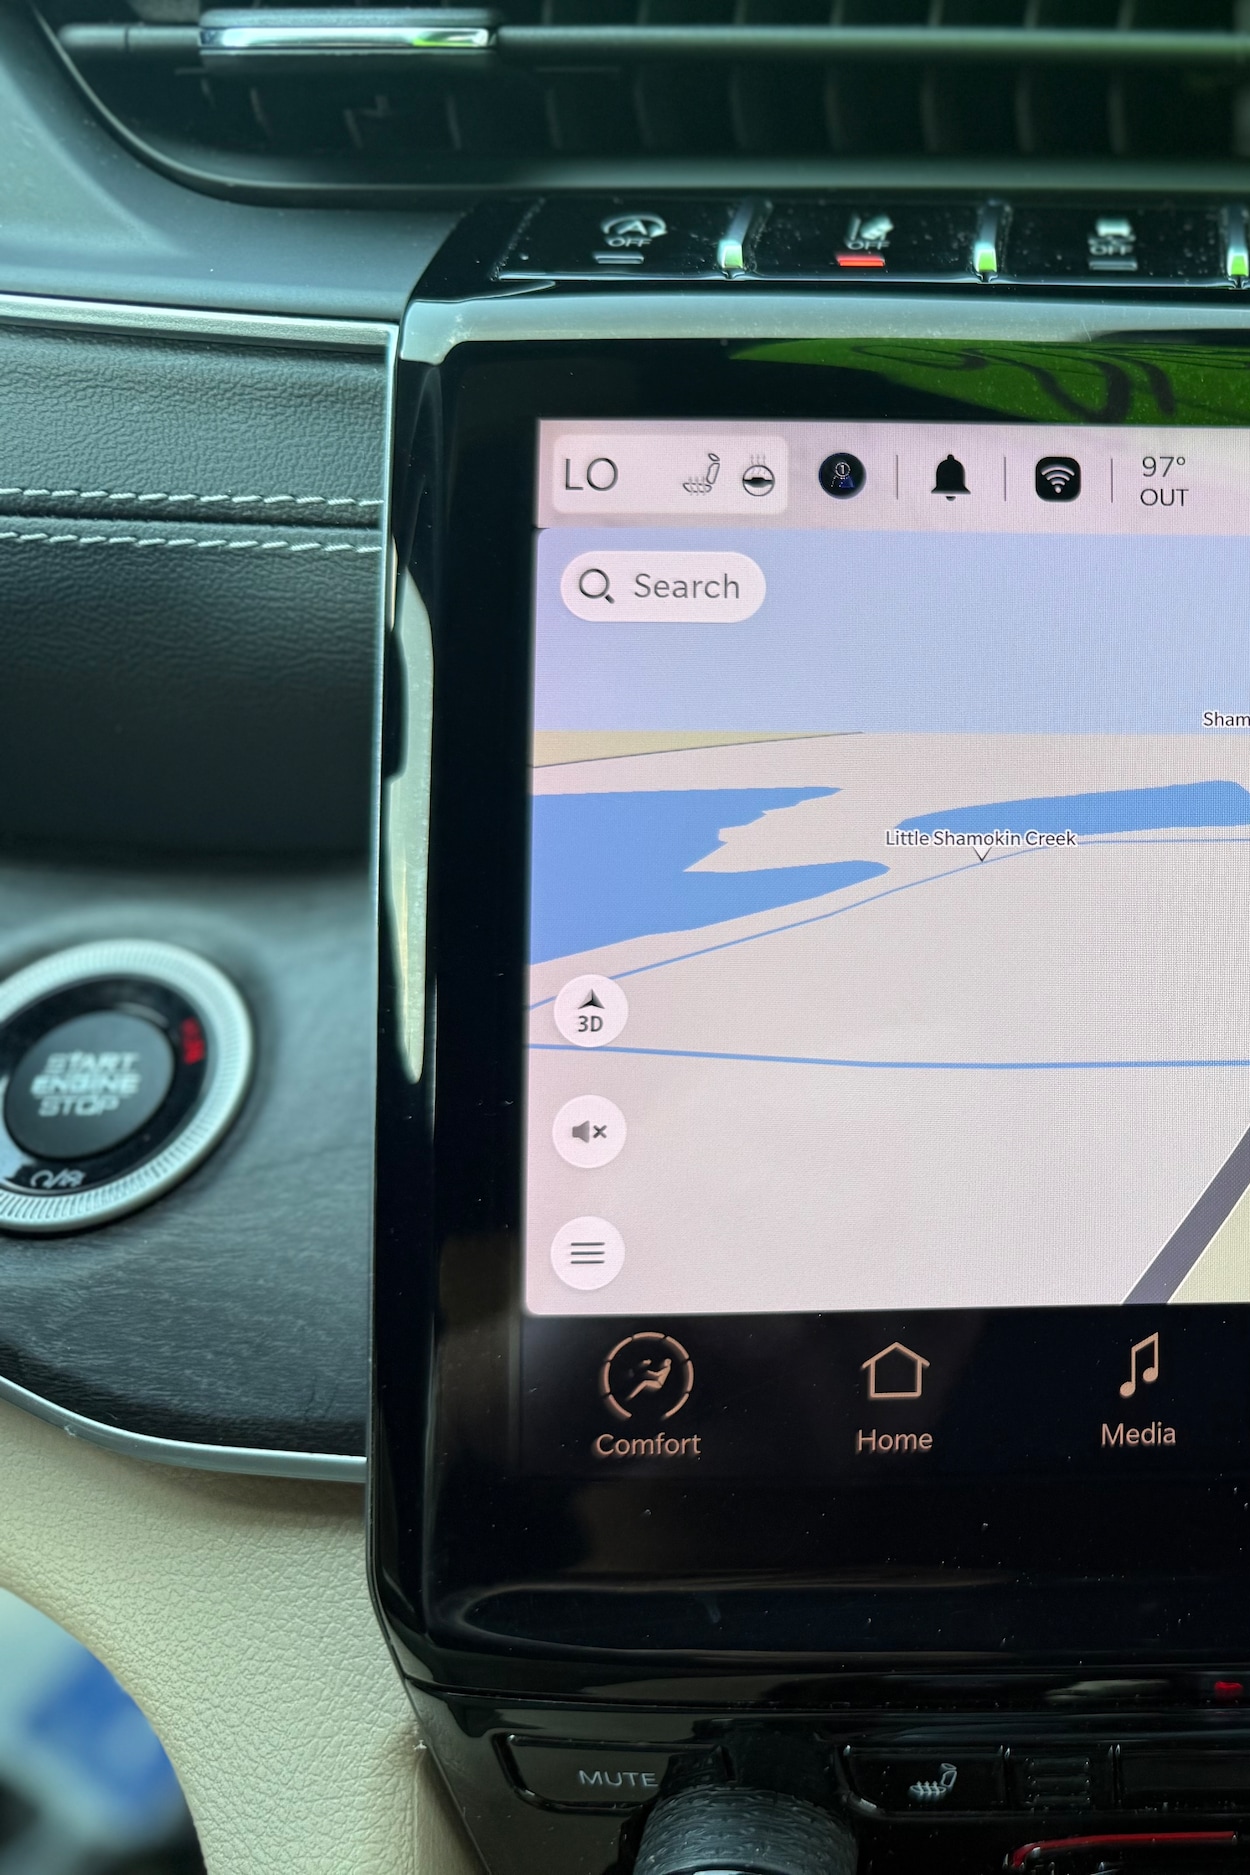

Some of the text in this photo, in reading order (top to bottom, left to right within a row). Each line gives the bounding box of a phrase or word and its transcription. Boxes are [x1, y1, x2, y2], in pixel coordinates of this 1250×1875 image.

[606, 236, 653, 248] OFF
[846, 240, 891, 251] OFF
[565, 457, 619, 492] LO
[1142, 456, 1186, 478] 97°
[1140, 488, 1189, 507] OUT
[633, 572, 740, 599] Search
[886, 830, 1077, 846] Little Shamokin Creek
[577, 1015, 604, 1032] 3D
[45, 1051, 139, 1076] START
[31, 1073, 139, 1099] ENGINE
[38, 1095, 119, 1118] STOP
[596, 1432, 702, 1456] Comfort
[857, 1429, 933, 1453] Home
[1101, 1422, 1177, 1447] Media
[579, 1769, 659, 1787] MUTE
